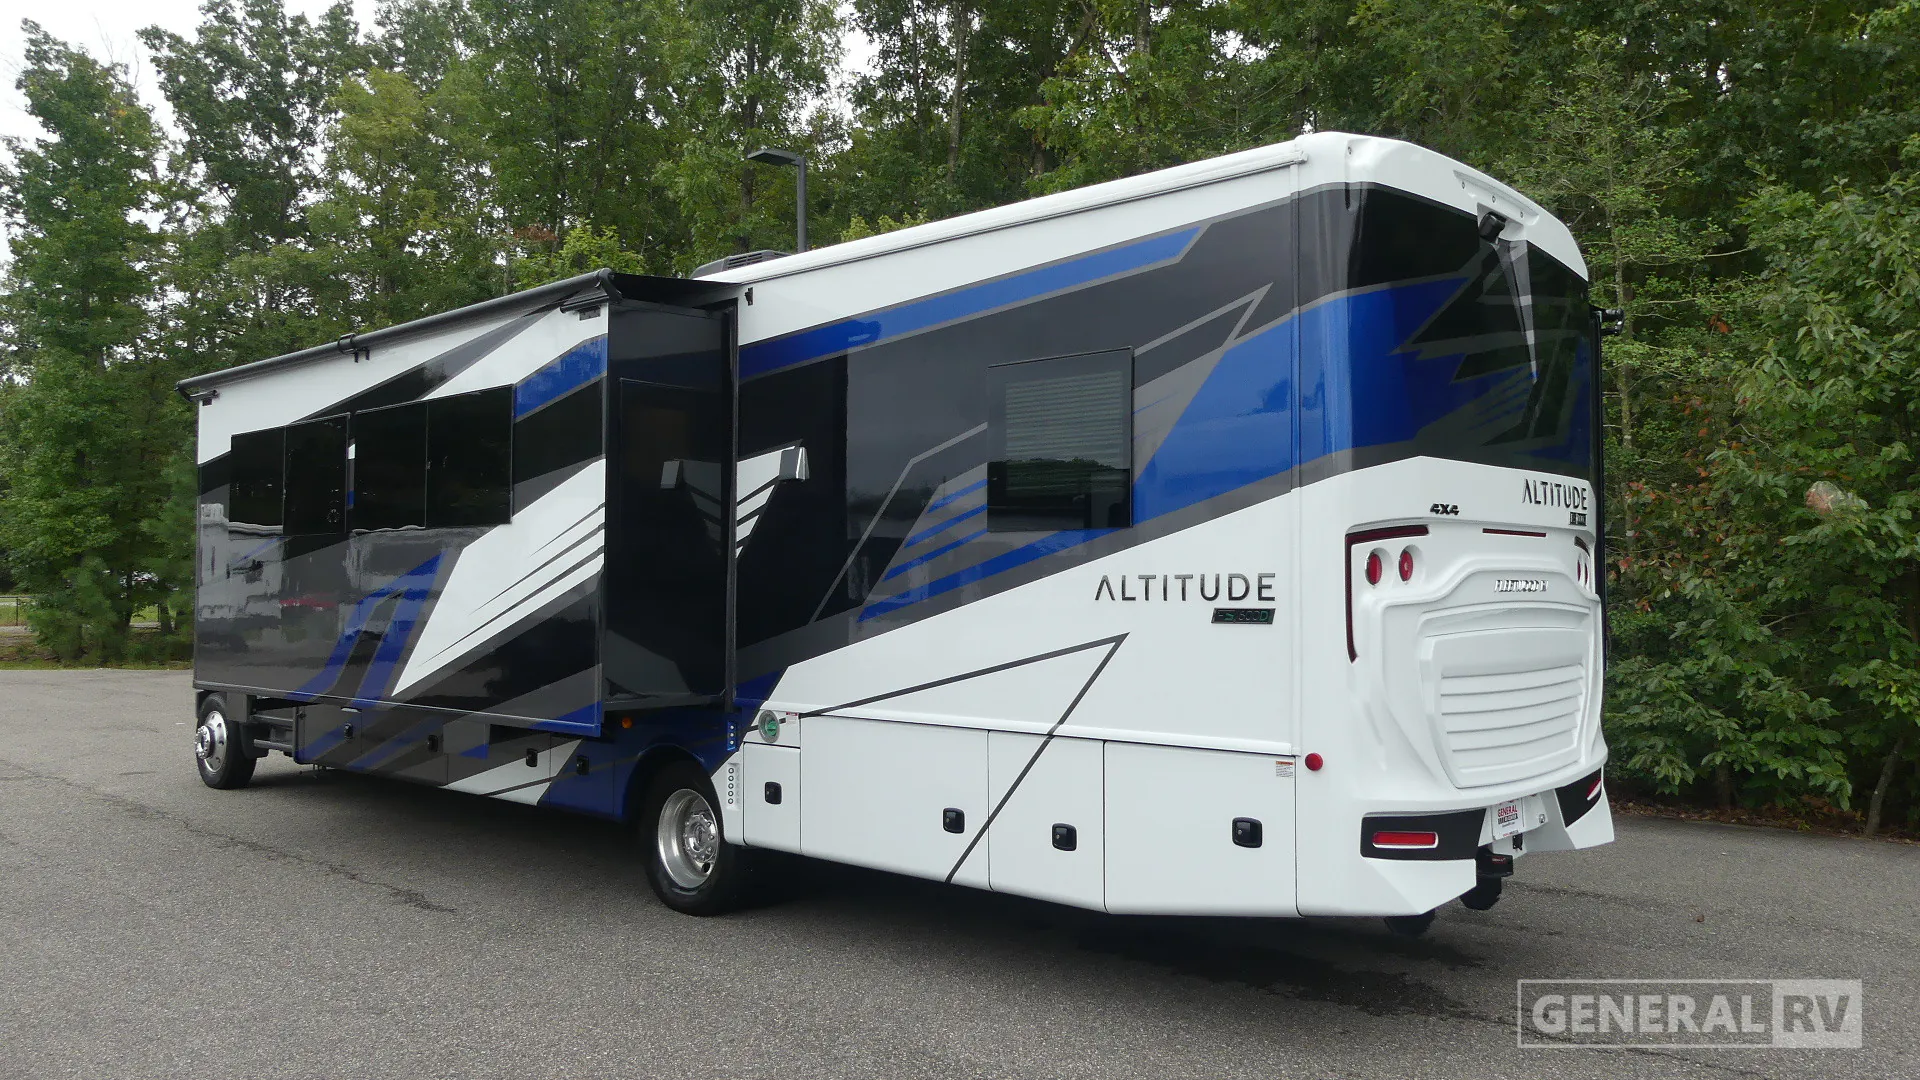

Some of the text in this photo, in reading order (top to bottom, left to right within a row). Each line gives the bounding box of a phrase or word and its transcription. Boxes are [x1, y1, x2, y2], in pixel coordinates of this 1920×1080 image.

[1522, 479, 1588, 510] ALTITUDE
[1094, 573, 1276, 602] ALTITUDE
[1498, 805, 1518, 817] GENERAL
